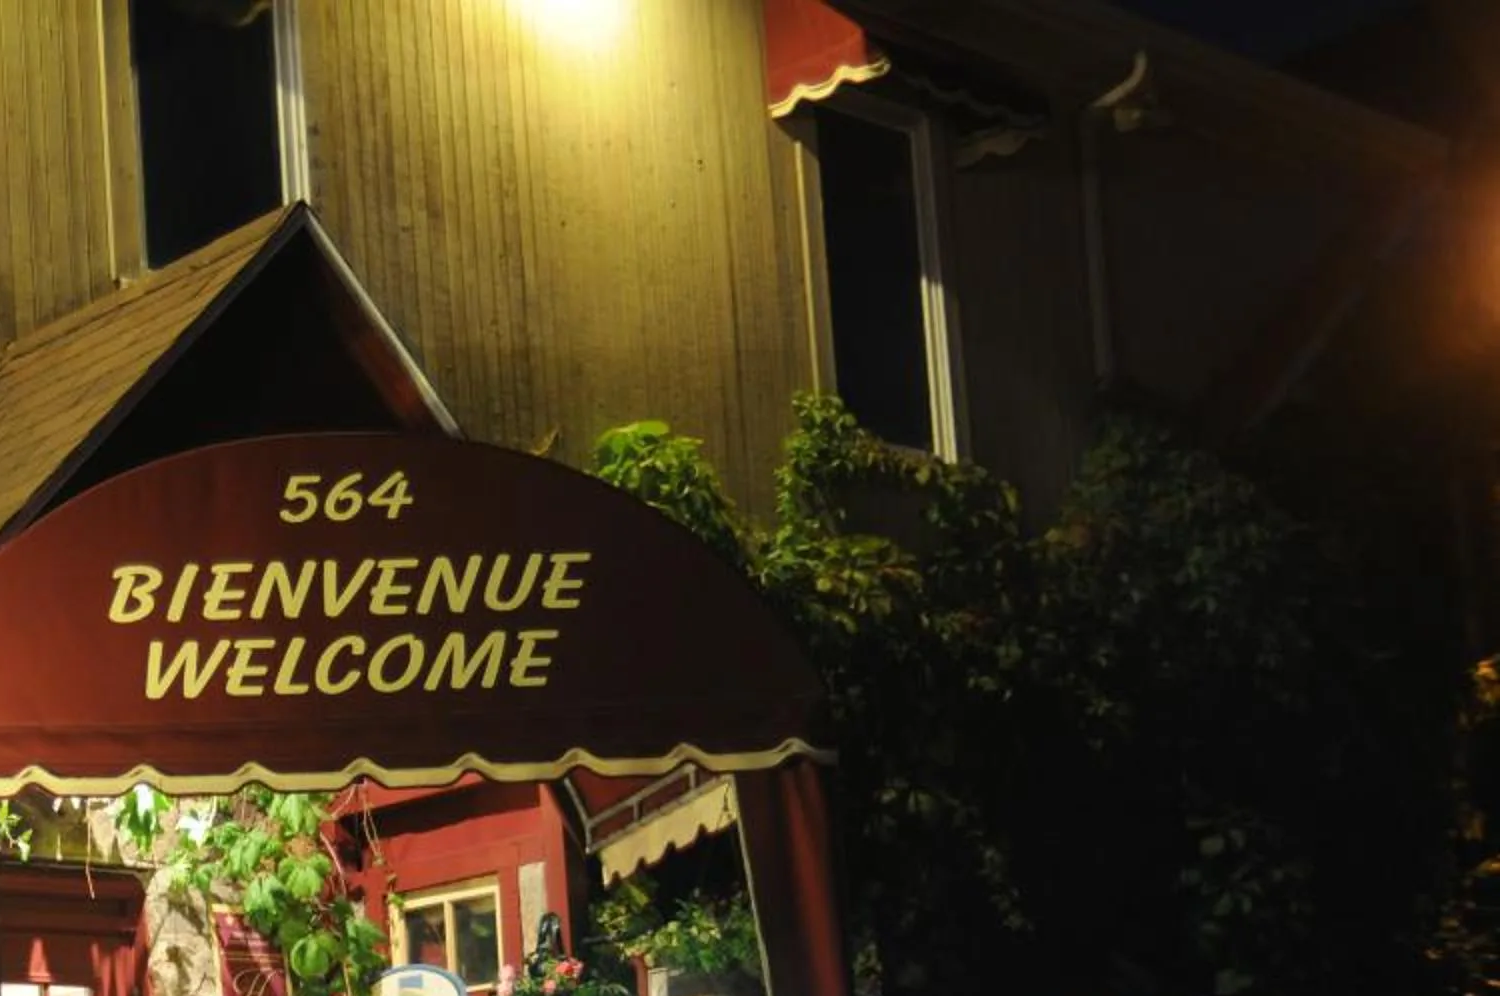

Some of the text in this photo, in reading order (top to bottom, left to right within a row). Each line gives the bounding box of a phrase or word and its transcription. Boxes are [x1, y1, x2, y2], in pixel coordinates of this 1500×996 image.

[279, 470, 414, 523] 564
[108, 552, 592, 624] BIENVENUE
[145, 629, 559, 700] WELCOME
